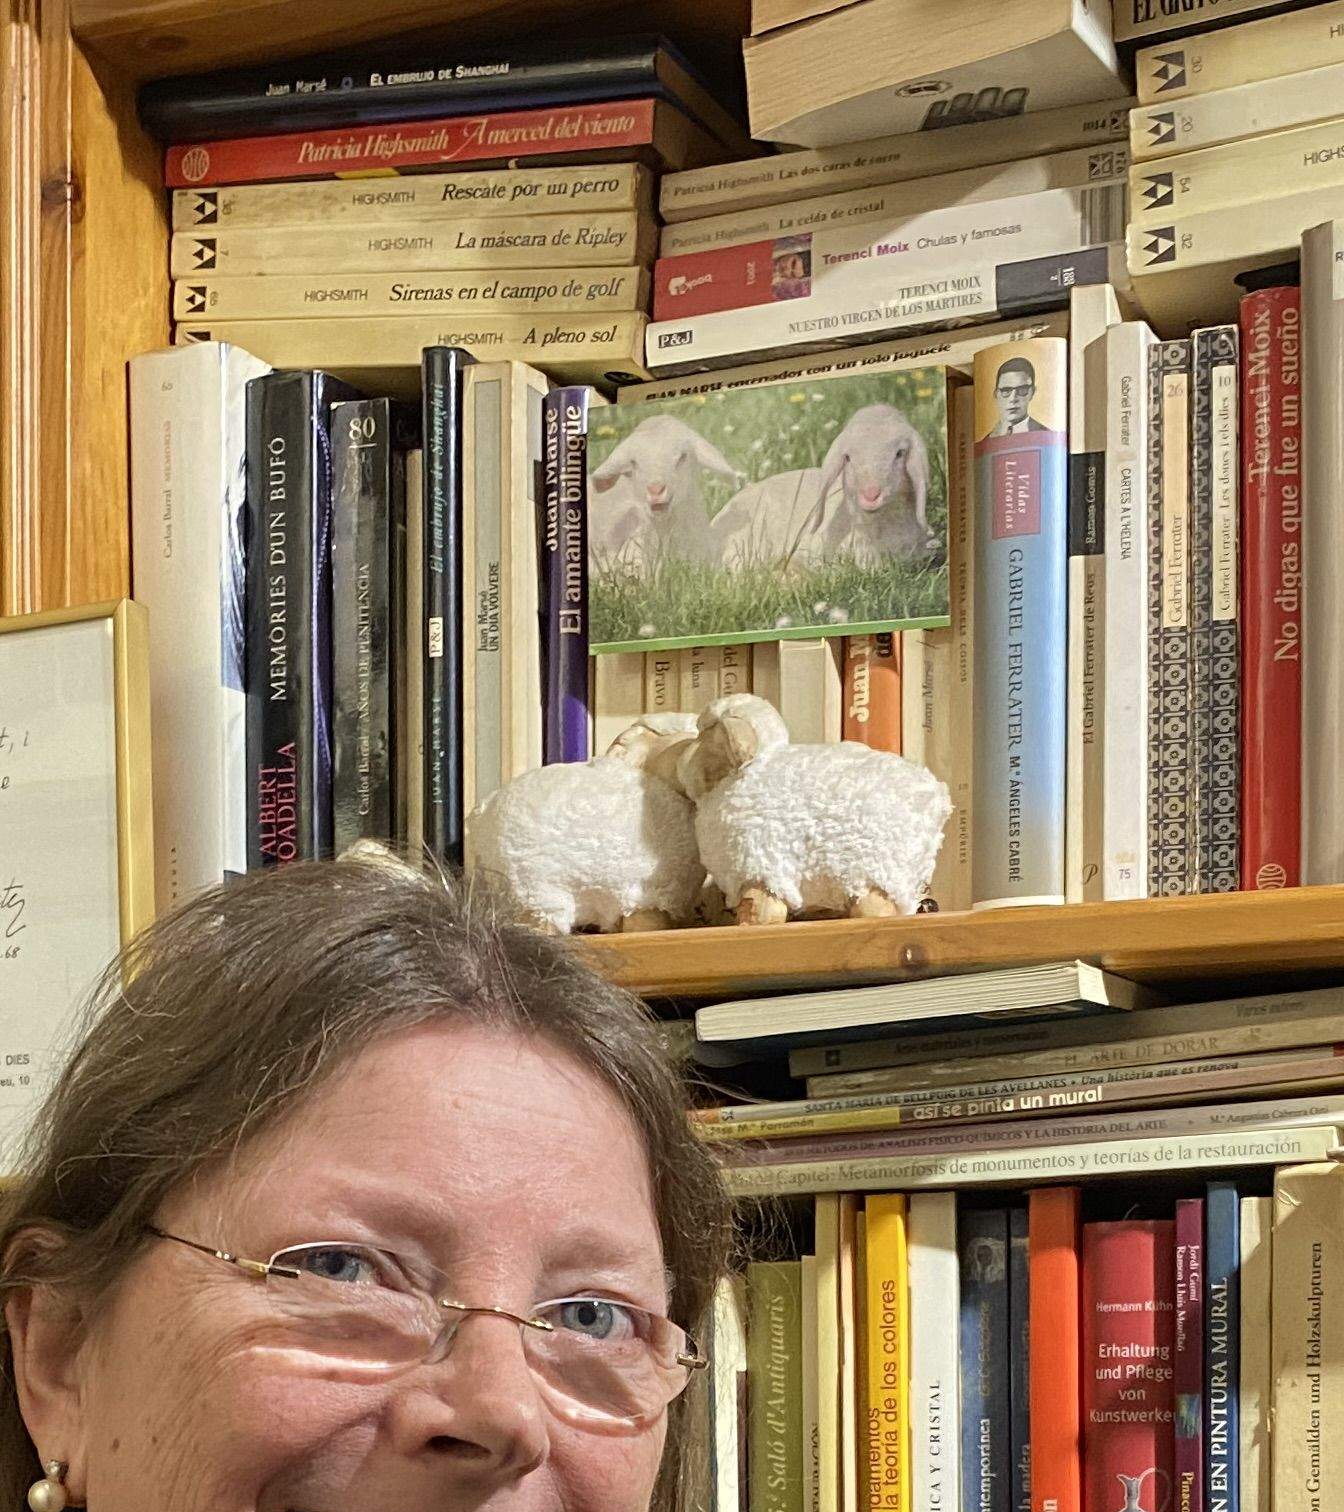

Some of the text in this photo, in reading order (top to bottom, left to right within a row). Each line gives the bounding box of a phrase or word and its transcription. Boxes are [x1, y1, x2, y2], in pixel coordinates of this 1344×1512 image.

[368, 236, 433, 252] HIGHSMITH
[455, 231, 477, 248] La
[482, 229, 553, 248] máscara
[576, 226, 627, 248] Ripley
[823, 220, 1021, 265] Terenci Moix Chulas y famosas
[659, 331, 692, 346] P&J
[1274, 306, 1302, 663] No digas que fue un sueño
[561, 404, 582, 636] El amante bilingüe
[271, 436, 285, 701] MEMÒRIES D'UN BUFÓ
[1008, 549, 1023, 637] GABRIEL
[1008, 643, 1023, 750] FERRATER
[23, 729, 29, 746] i
[259, 765, 276, 856] ALBERT
[1009, 779, 1023, 836] ÁNGELES
[1008, 841, 1022, 882] CABRÉ
[6, 1053, 29, 1066] DIES
[19, 1075, 29, 1086] 10
[913, 1085, 1103, 1119] así se pinta un mural
[1098, 1343, 1169, 1360] Erhaltung
[1095, 1365, 1173, 1382] und Pflege
[1118, 1389, 1145, 1401] von
[929, 1380, 941, 1456] CRISTAL
[1090, 1408, 1175, 1422] Kunstwerke
[929, 1464, 941, 1474] Y
